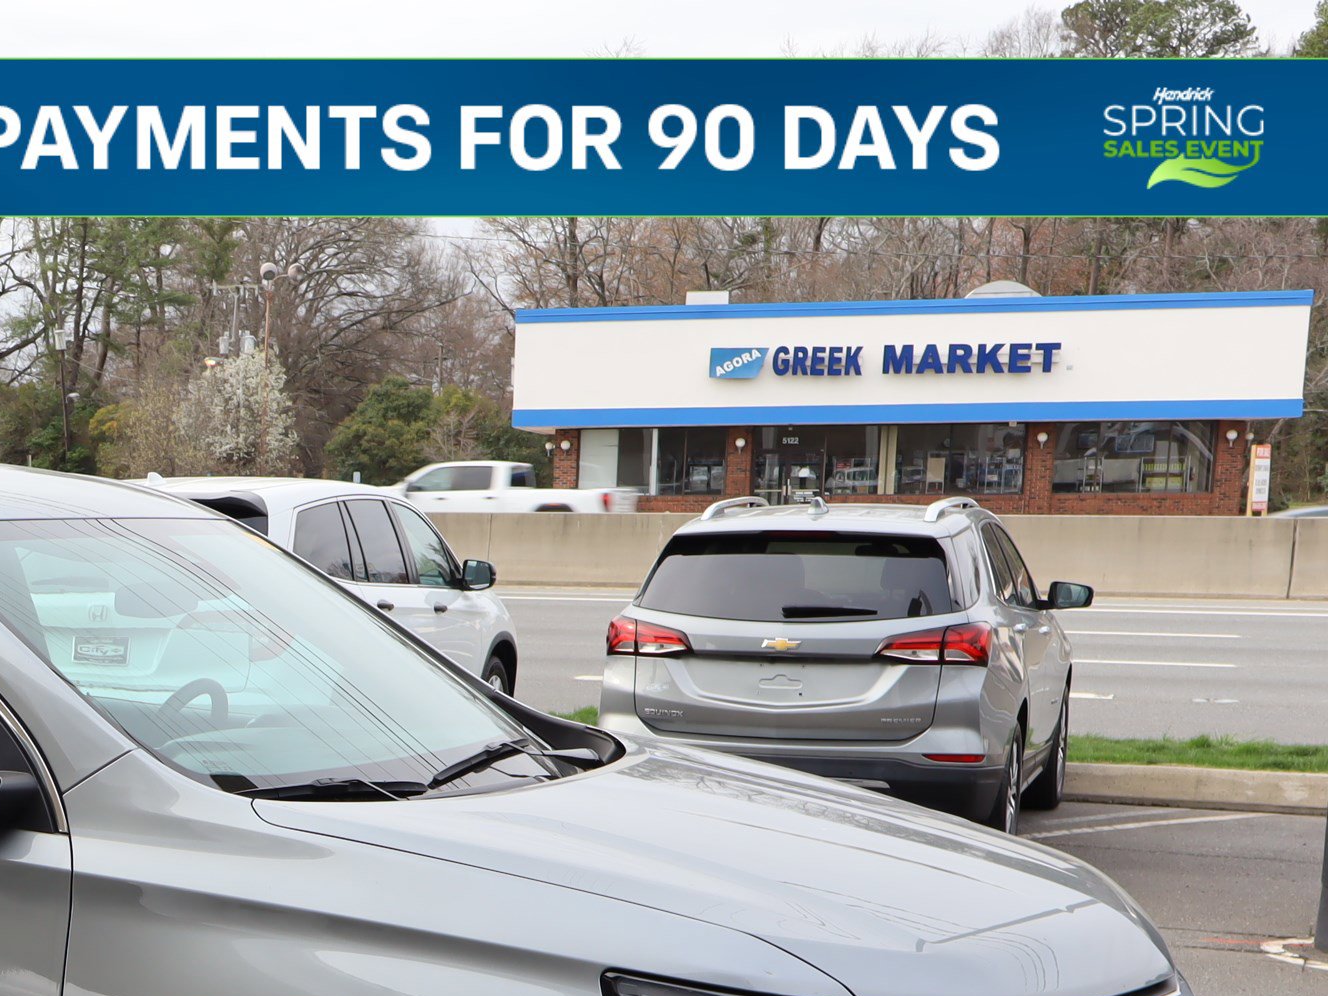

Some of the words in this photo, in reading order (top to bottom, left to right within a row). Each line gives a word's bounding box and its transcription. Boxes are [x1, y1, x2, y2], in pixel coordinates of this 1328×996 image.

[715, 348, 762, 377] AGORA
[772, 345, 864, 377] GREEK
[882, 342, 1062, 375] MARKET
[782, 437, 799, 445] 5122
[644, 707, 684, 717] EQUINOX
